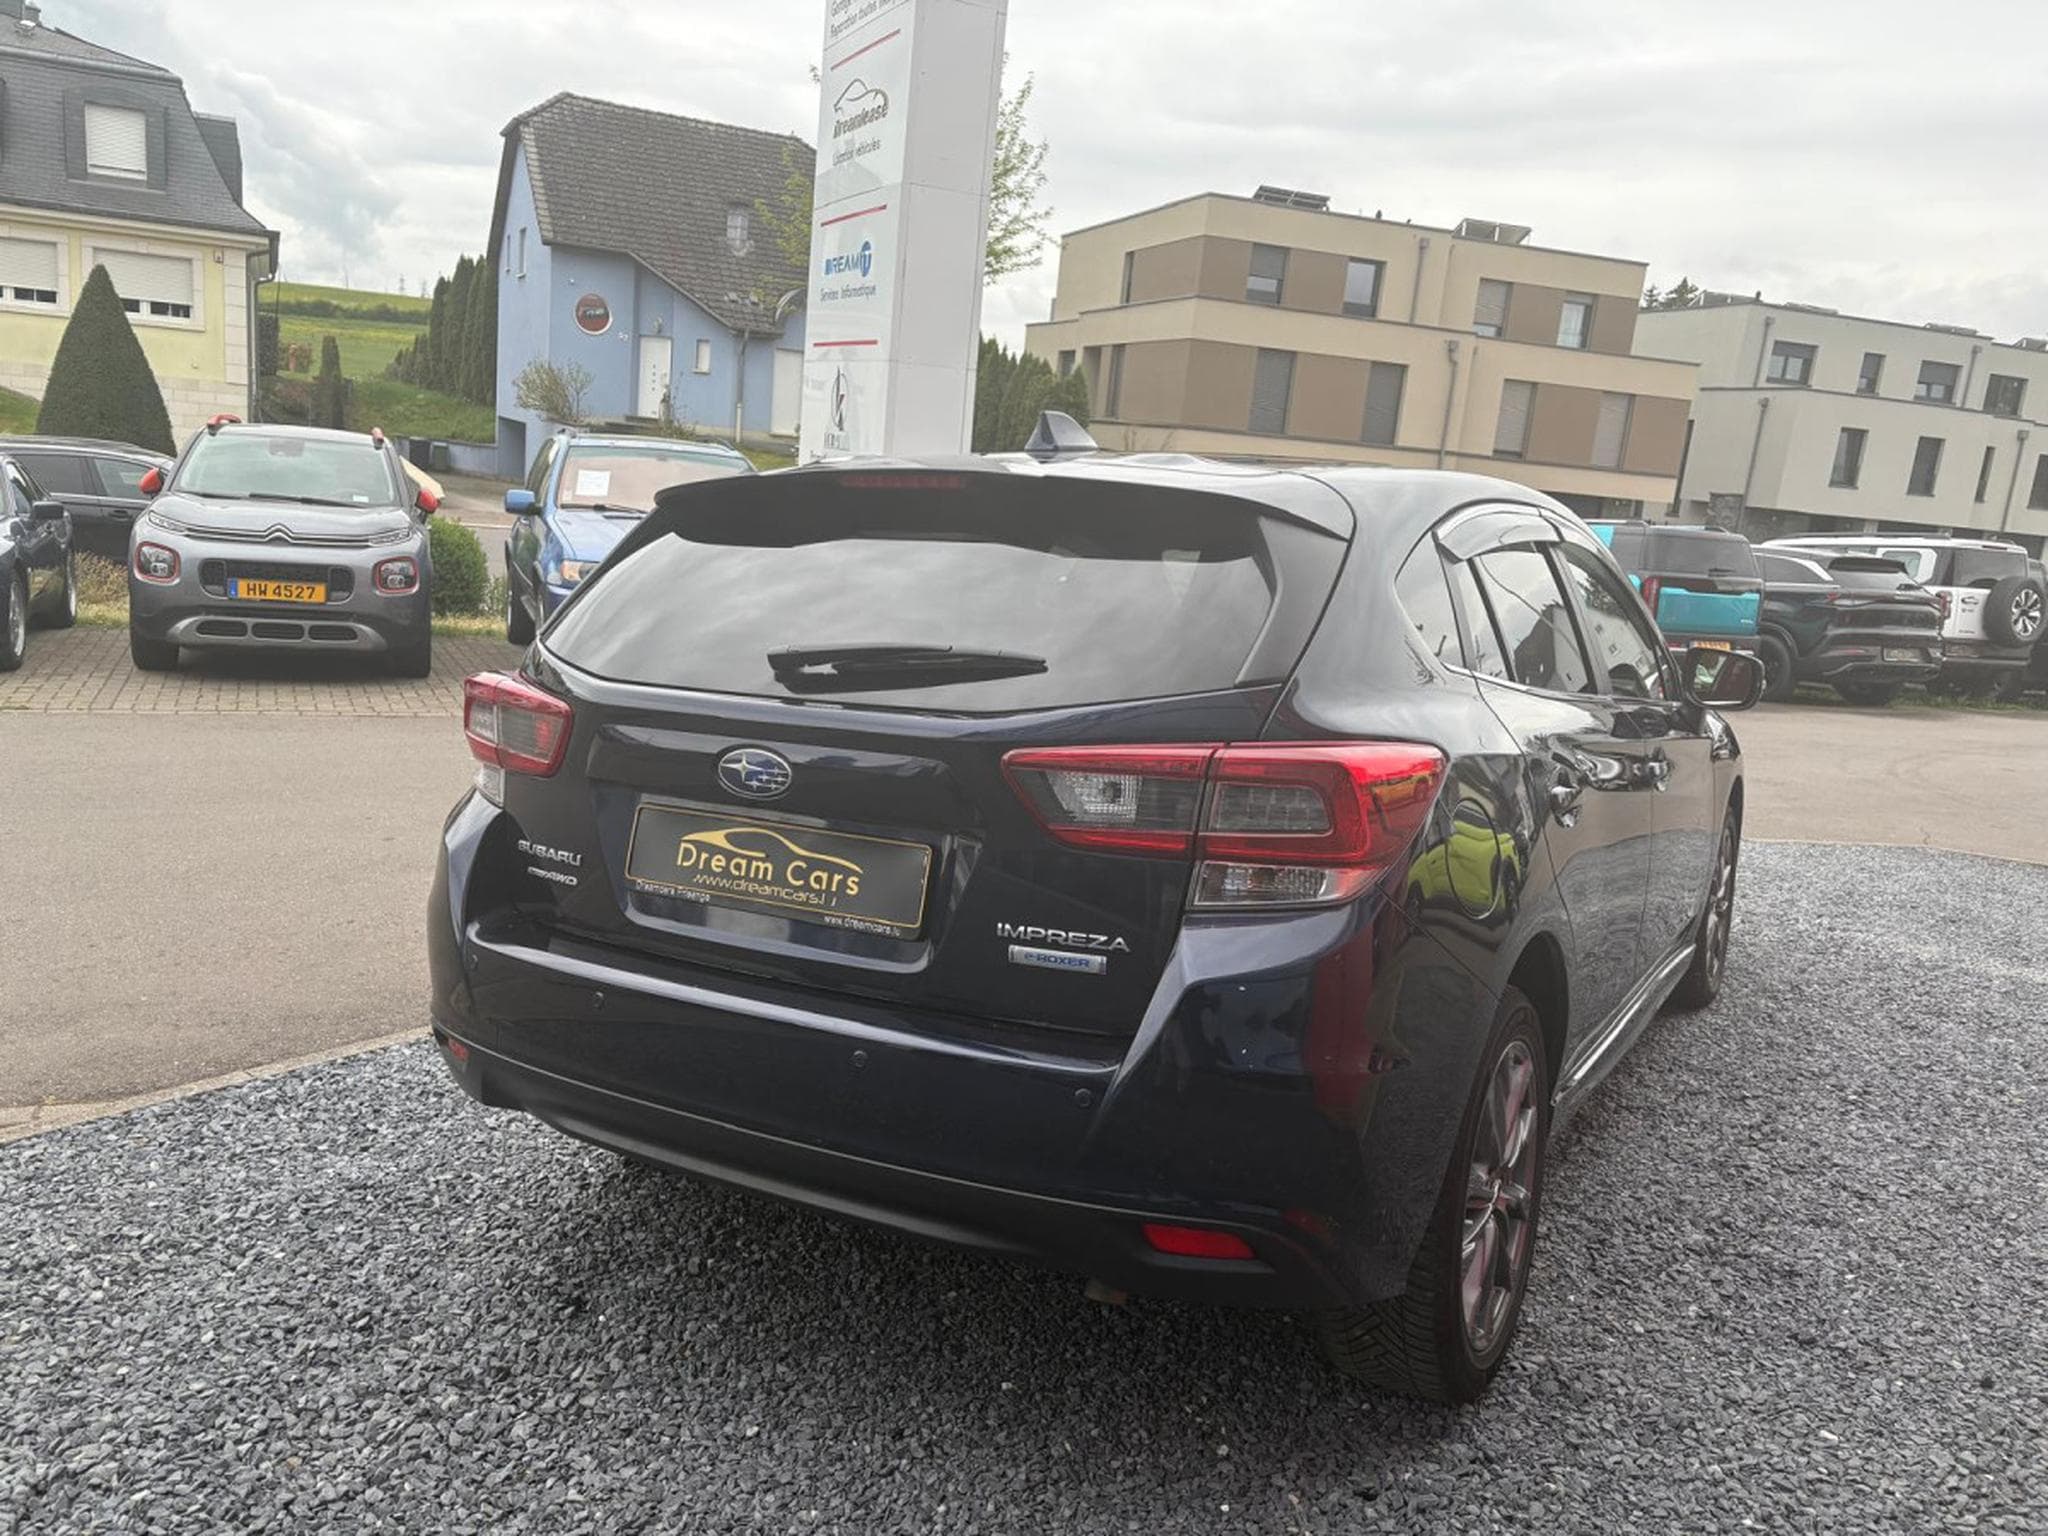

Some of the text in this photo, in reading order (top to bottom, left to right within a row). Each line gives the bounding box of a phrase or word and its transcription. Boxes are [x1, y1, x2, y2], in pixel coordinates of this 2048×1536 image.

[246, 583, 316, 600] HW 4527
[518, 839, 581, 866] SUBARU
[676, 842, 860, 896] Dream Cars
[996, 922, 1131, 952] IMPREZA
